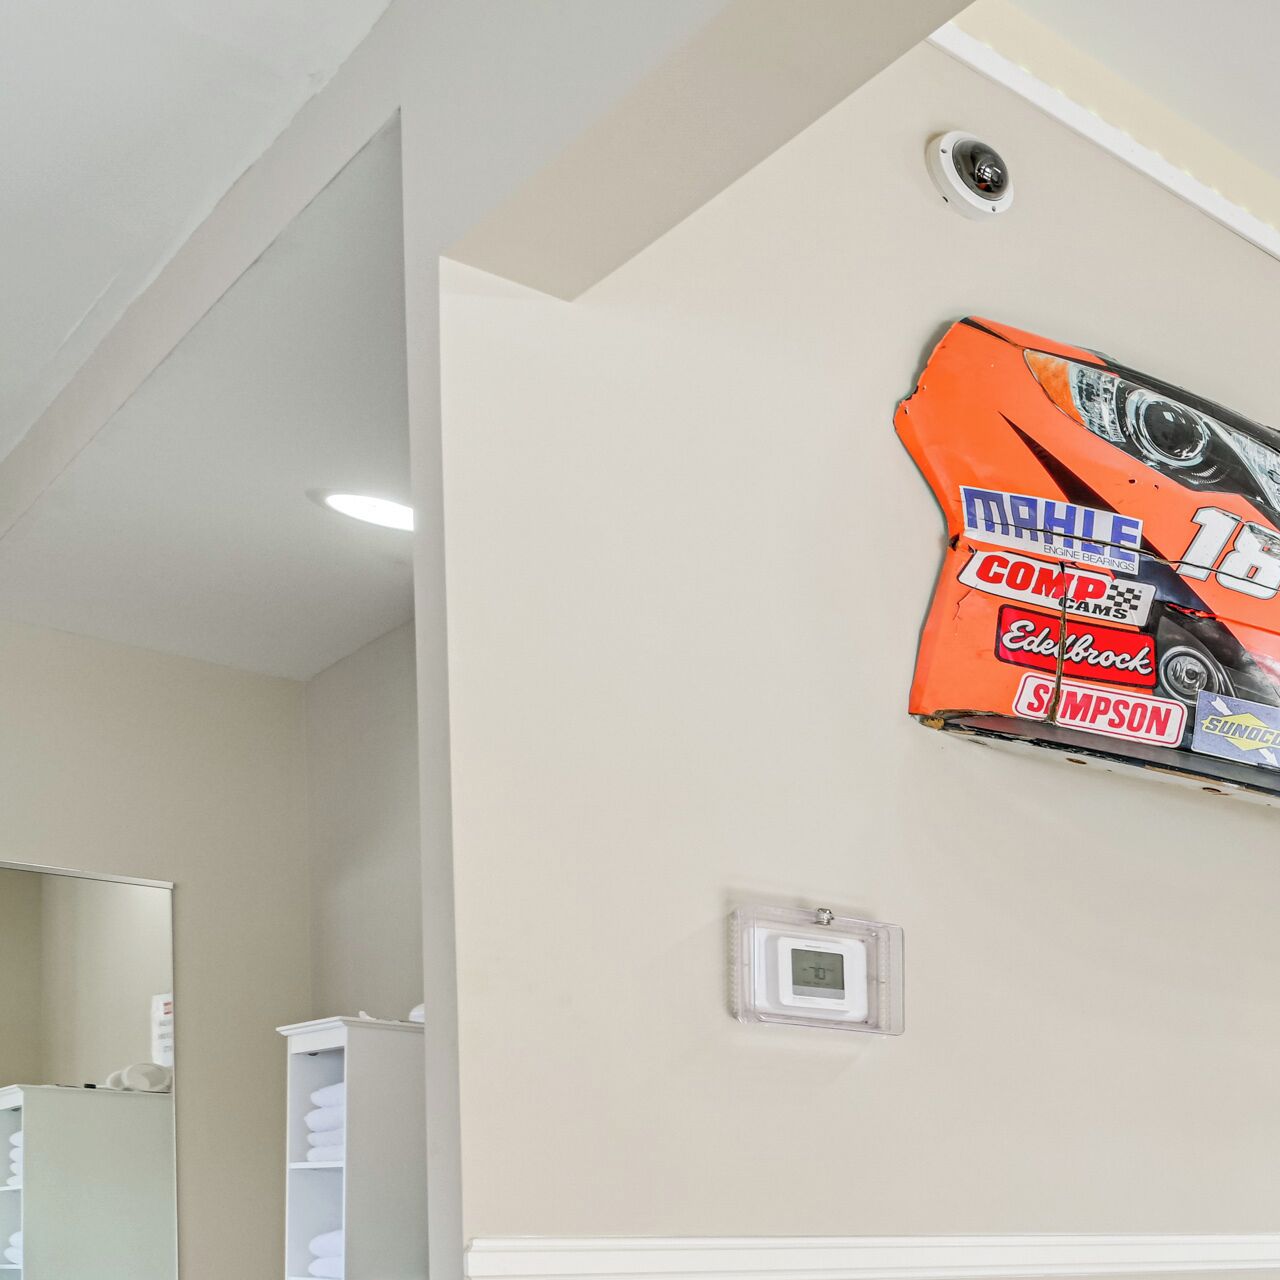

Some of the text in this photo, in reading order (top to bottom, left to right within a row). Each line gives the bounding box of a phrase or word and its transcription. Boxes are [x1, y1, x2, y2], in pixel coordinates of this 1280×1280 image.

[963, 488, 1140, 562] MAHLE
[975, 554, 1107, 603] COMP
[1043, 544, 1136, 572] ENGINE BEARINGS
[1058, 596, 1129, 620] CAMS
[1001, 619, 1154, 675] Edelbrock
[1026, 683, 1173, 737] SIMPSON
